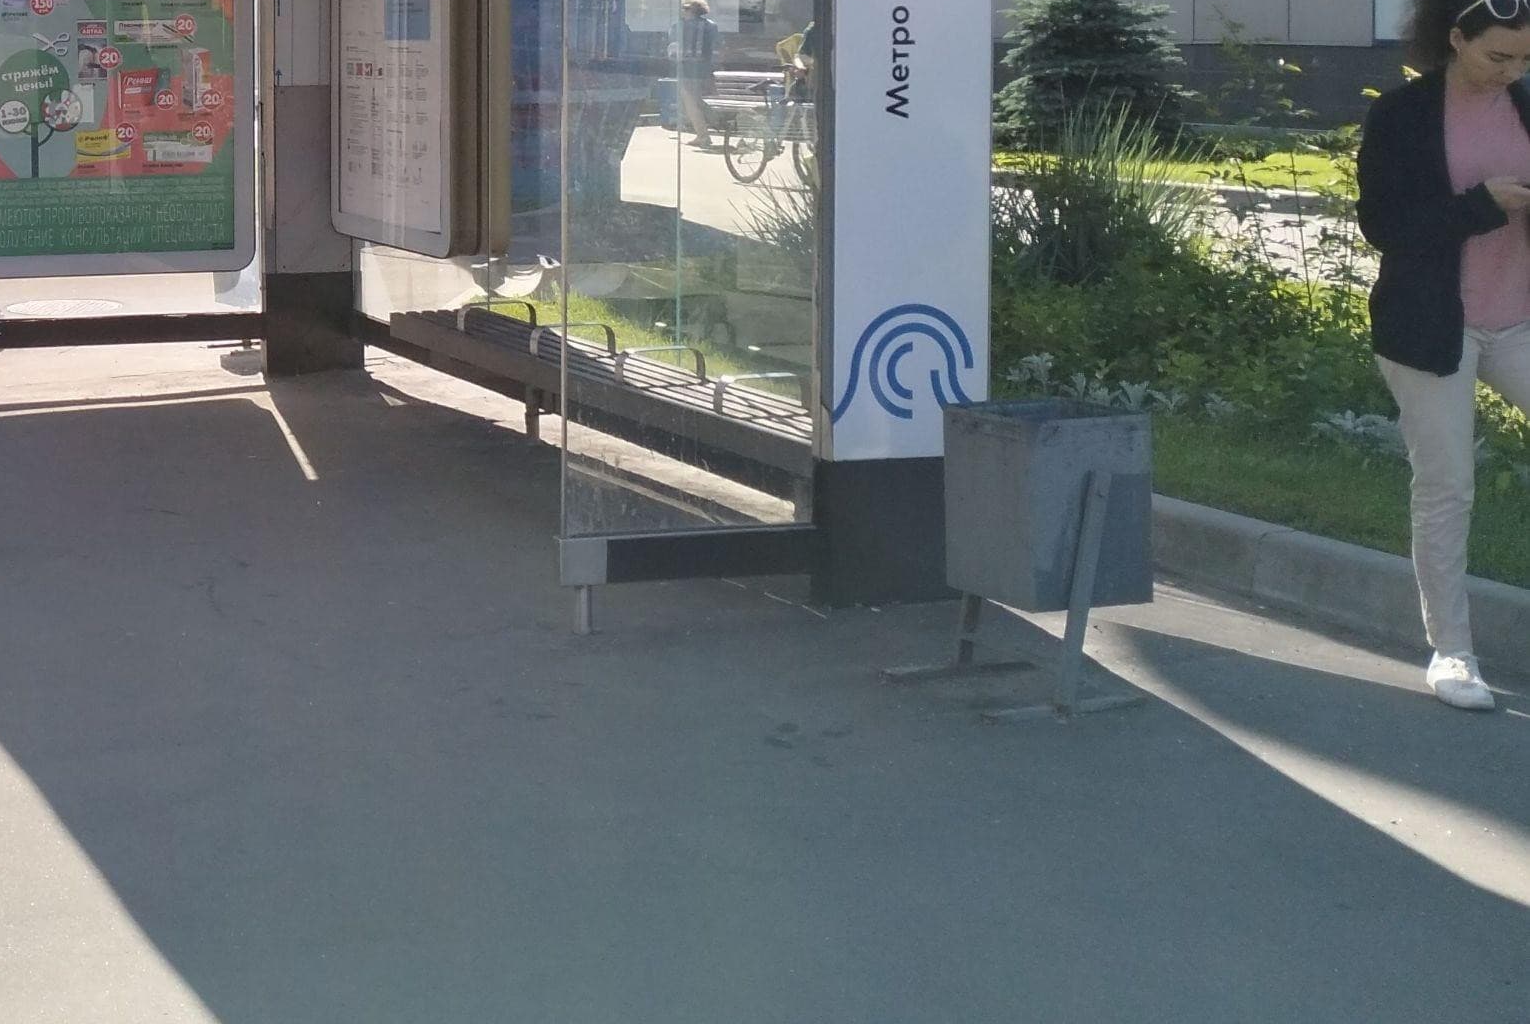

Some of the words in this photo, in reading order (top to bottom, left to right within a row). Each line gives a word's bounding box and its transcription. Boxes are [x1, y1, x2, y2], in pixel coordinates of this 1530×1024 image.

[177, 19, 193, 31] 20
[101, 52, 119, 64] 20
[886, 5, 916, 119] Метро
[1, 65, 60, 82] стрижём
[15, 77, 53, 92] цены!
[158, 94, 174, 105] 20
[204, 93, 220, 105] 20
[117, 127, 134, 138] 20
[195, 125, 211, 137] 20
